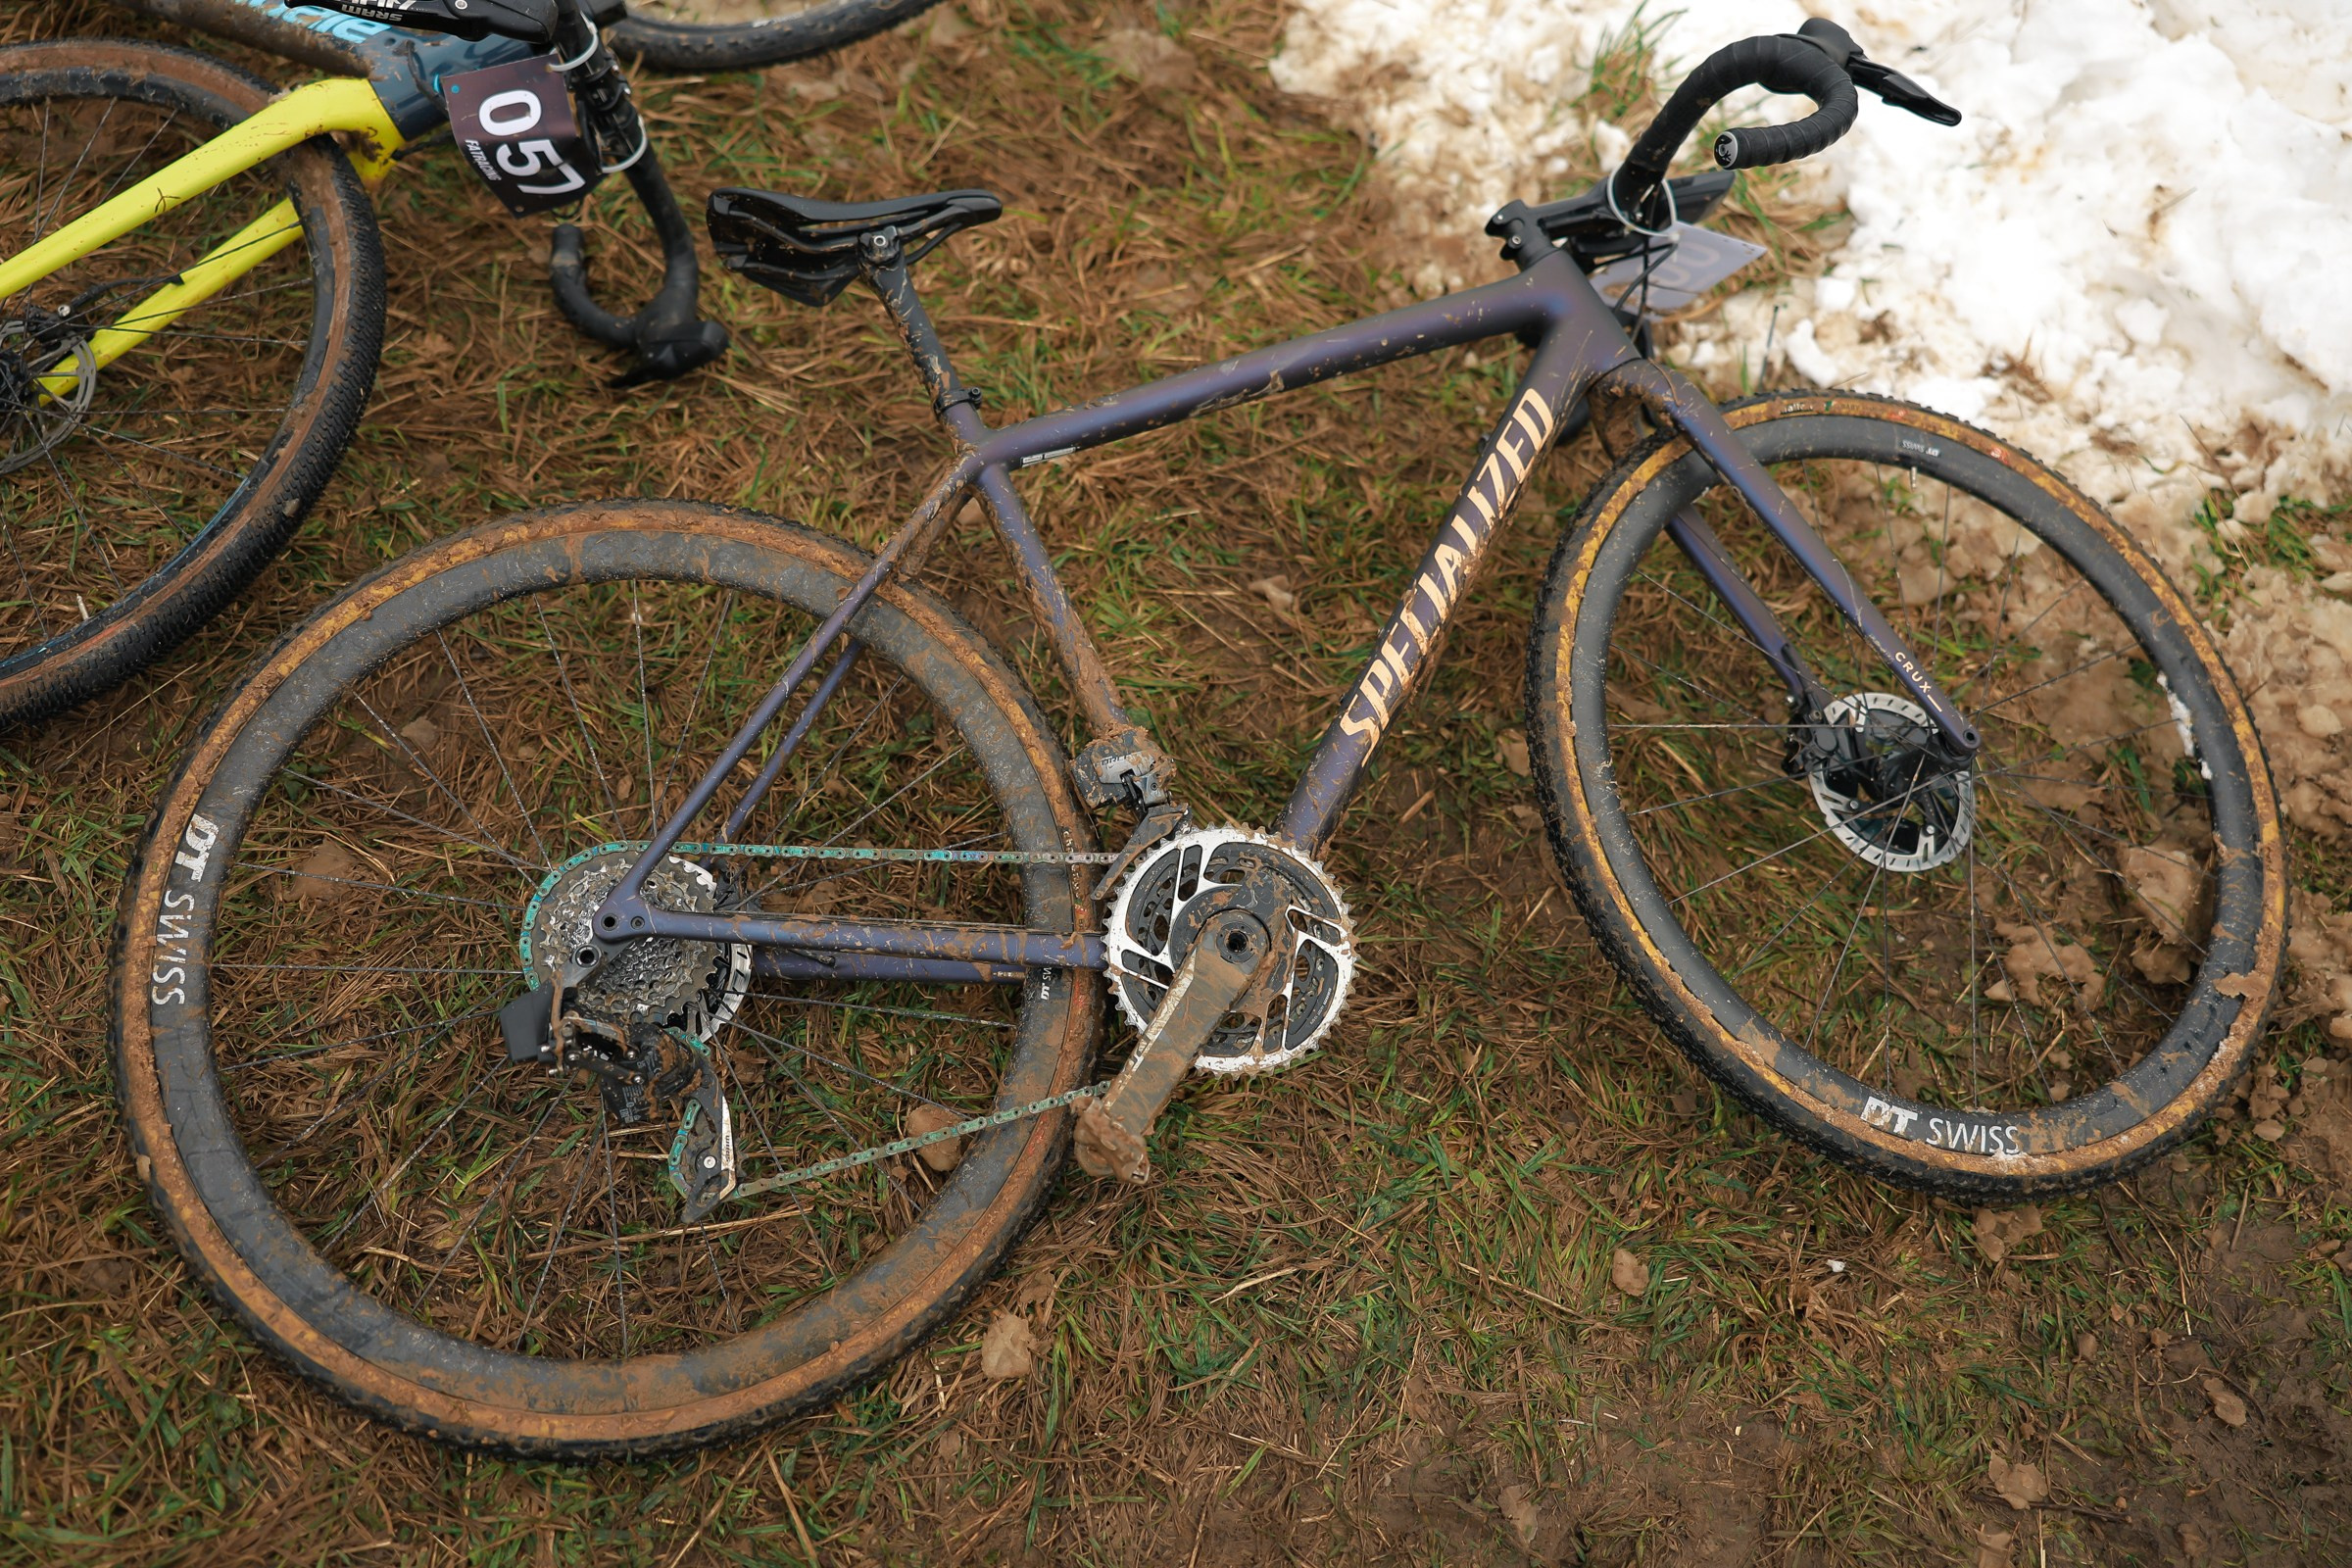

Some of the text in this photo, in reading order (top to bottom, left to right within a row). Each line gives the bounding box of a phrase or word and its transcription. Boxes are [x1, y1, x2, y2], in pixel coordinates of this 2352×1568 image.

[341, 4, 403, 22] SRAM
[465, 139, 502, 181] FATRACING
[479, 89, 586, 195] 057
[1340, 388, 1553, 767] SPECIALIZED
[1895, 652, 1932, 693] CRUX
[152, 813, 220, 1005] DT SWISS
[1860, 1096, 2021, 1154] DT SWISS
